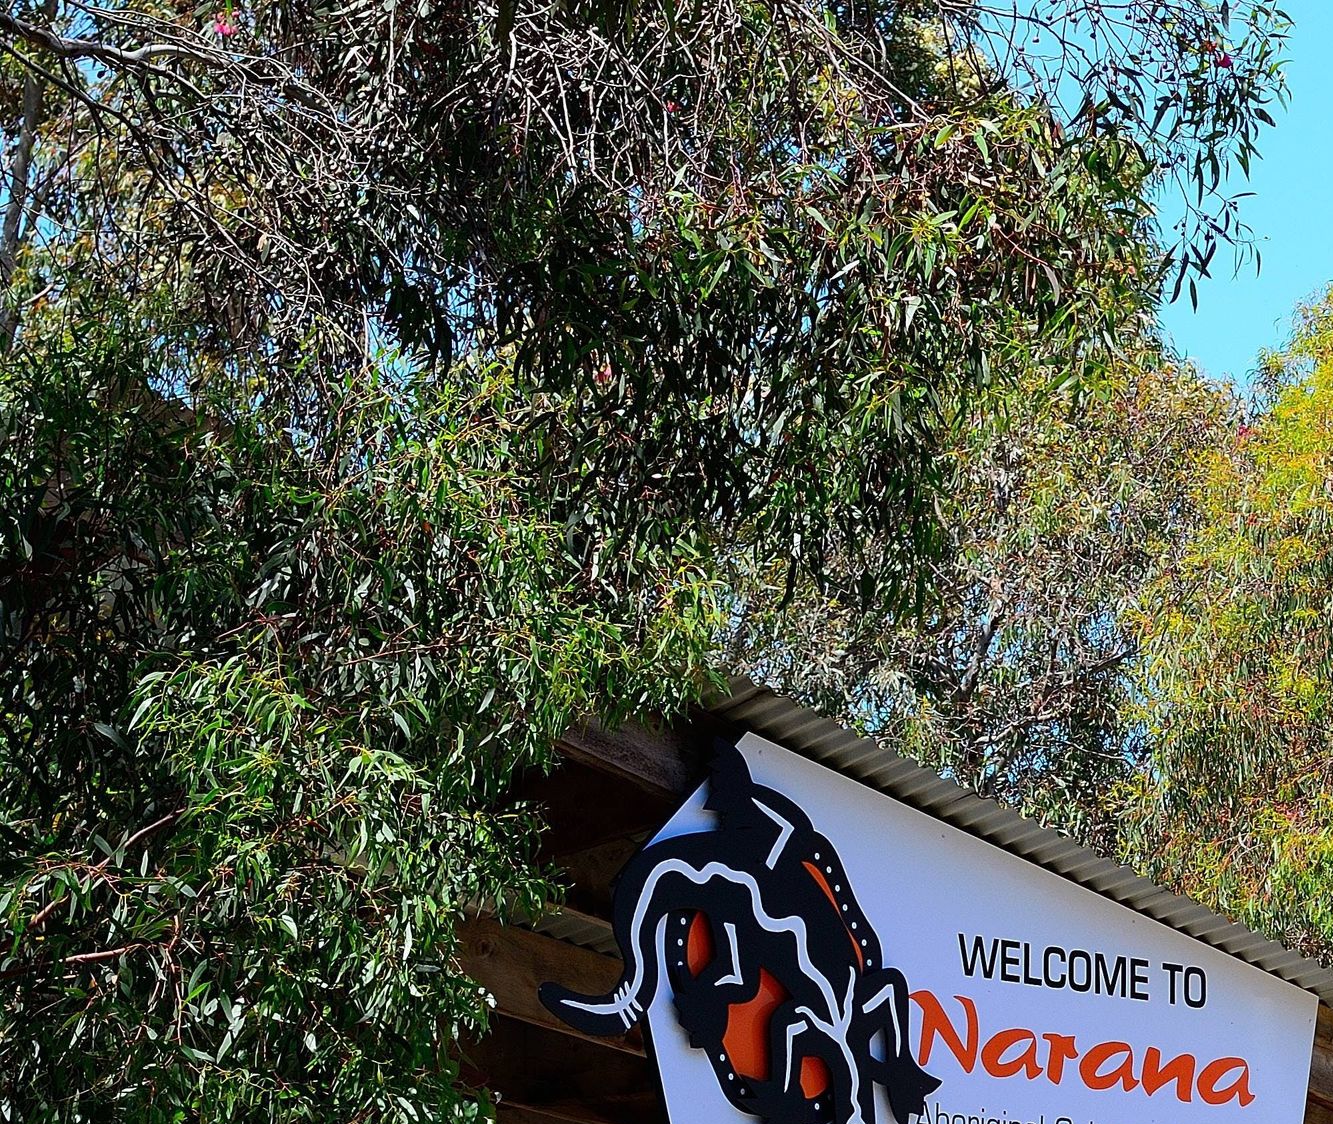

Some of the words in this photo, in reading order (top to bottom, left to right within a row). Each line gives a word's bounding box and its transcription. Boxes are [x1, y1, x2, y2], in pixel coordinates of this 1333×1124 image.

[958, 932, 1149, 1001] WELCOME
[1162, 962, 1207, 1009] TO
[908, 990, 1255, 1107] Narana
